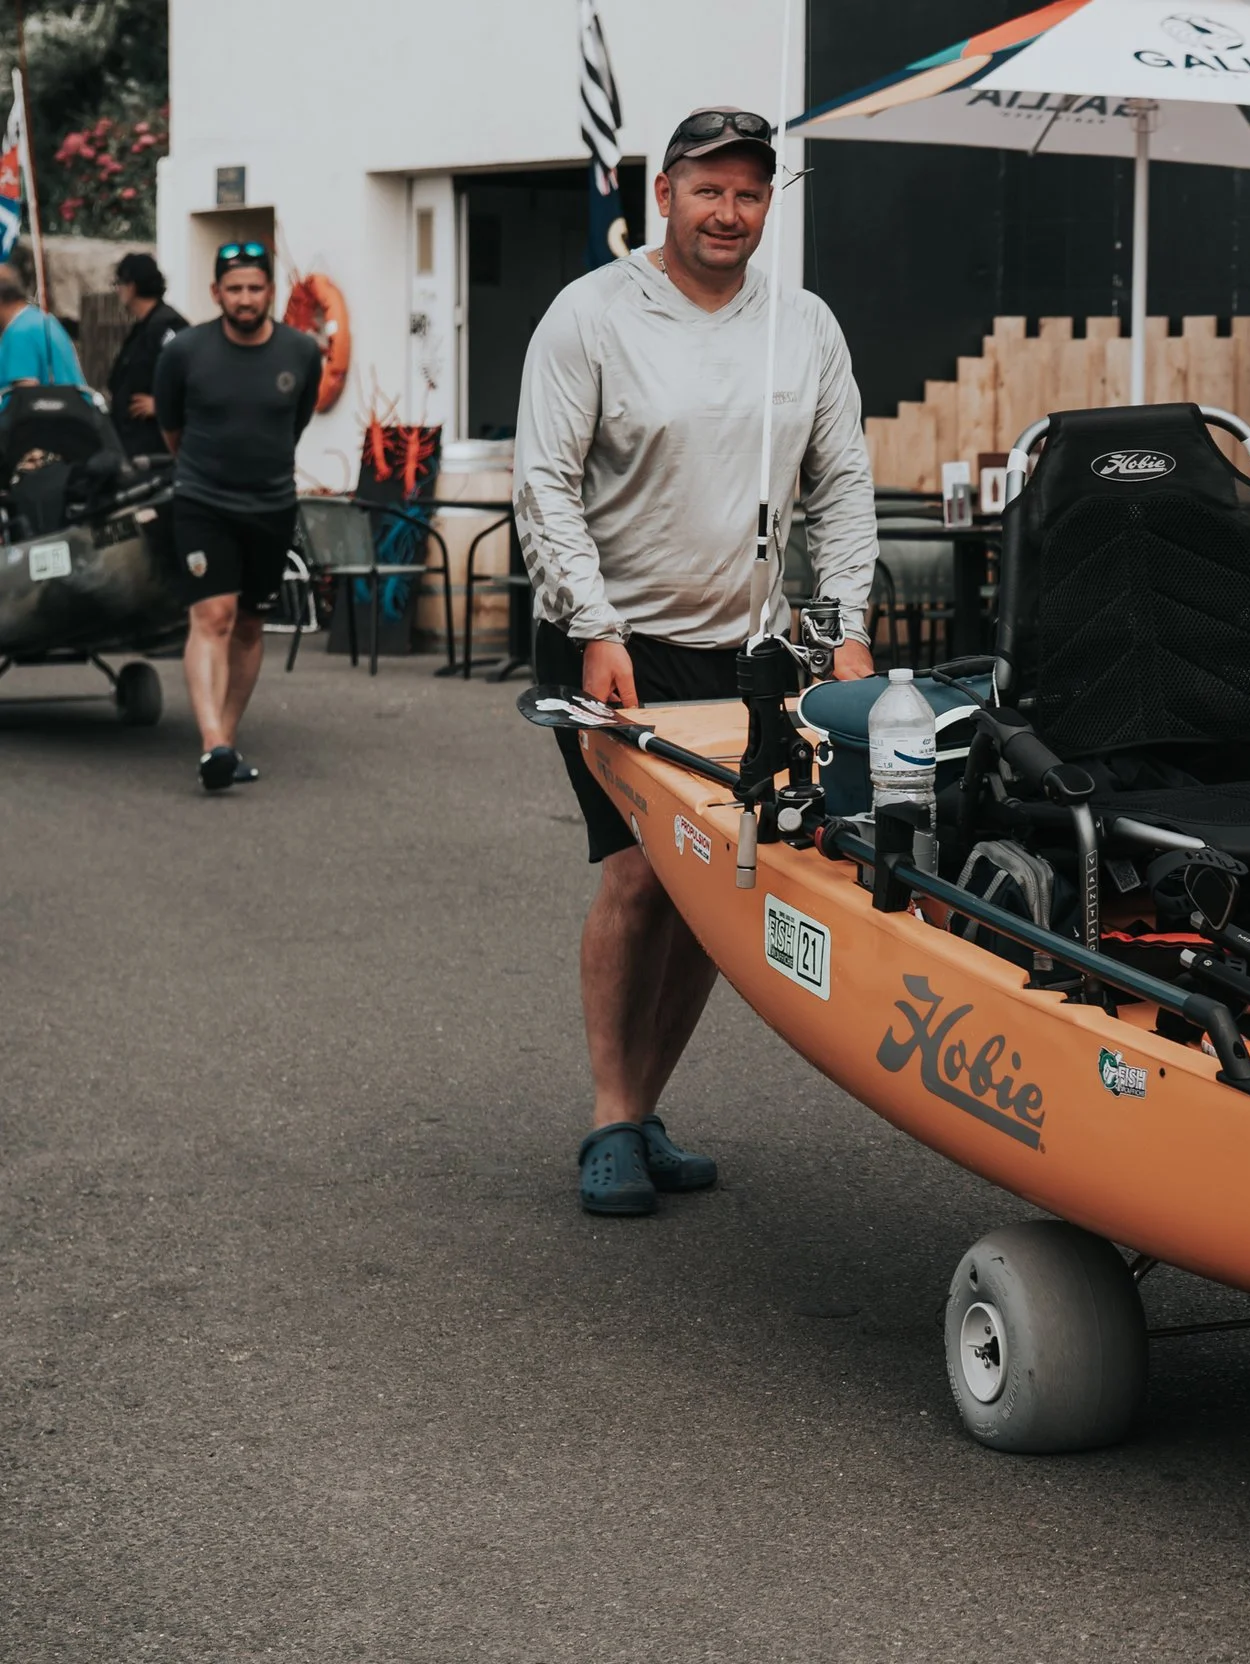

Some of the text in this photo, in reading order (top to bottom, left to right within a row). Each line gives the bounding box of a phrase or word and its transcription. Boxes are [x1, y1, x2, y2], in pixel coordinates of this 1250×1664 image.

[1100, 453, 1167, 475] Hobie
[802, 931, 816, 975] 21
[876, 974, 1045, 1151] Hobie
[1117, 1065, 1146, 1091] FISH
